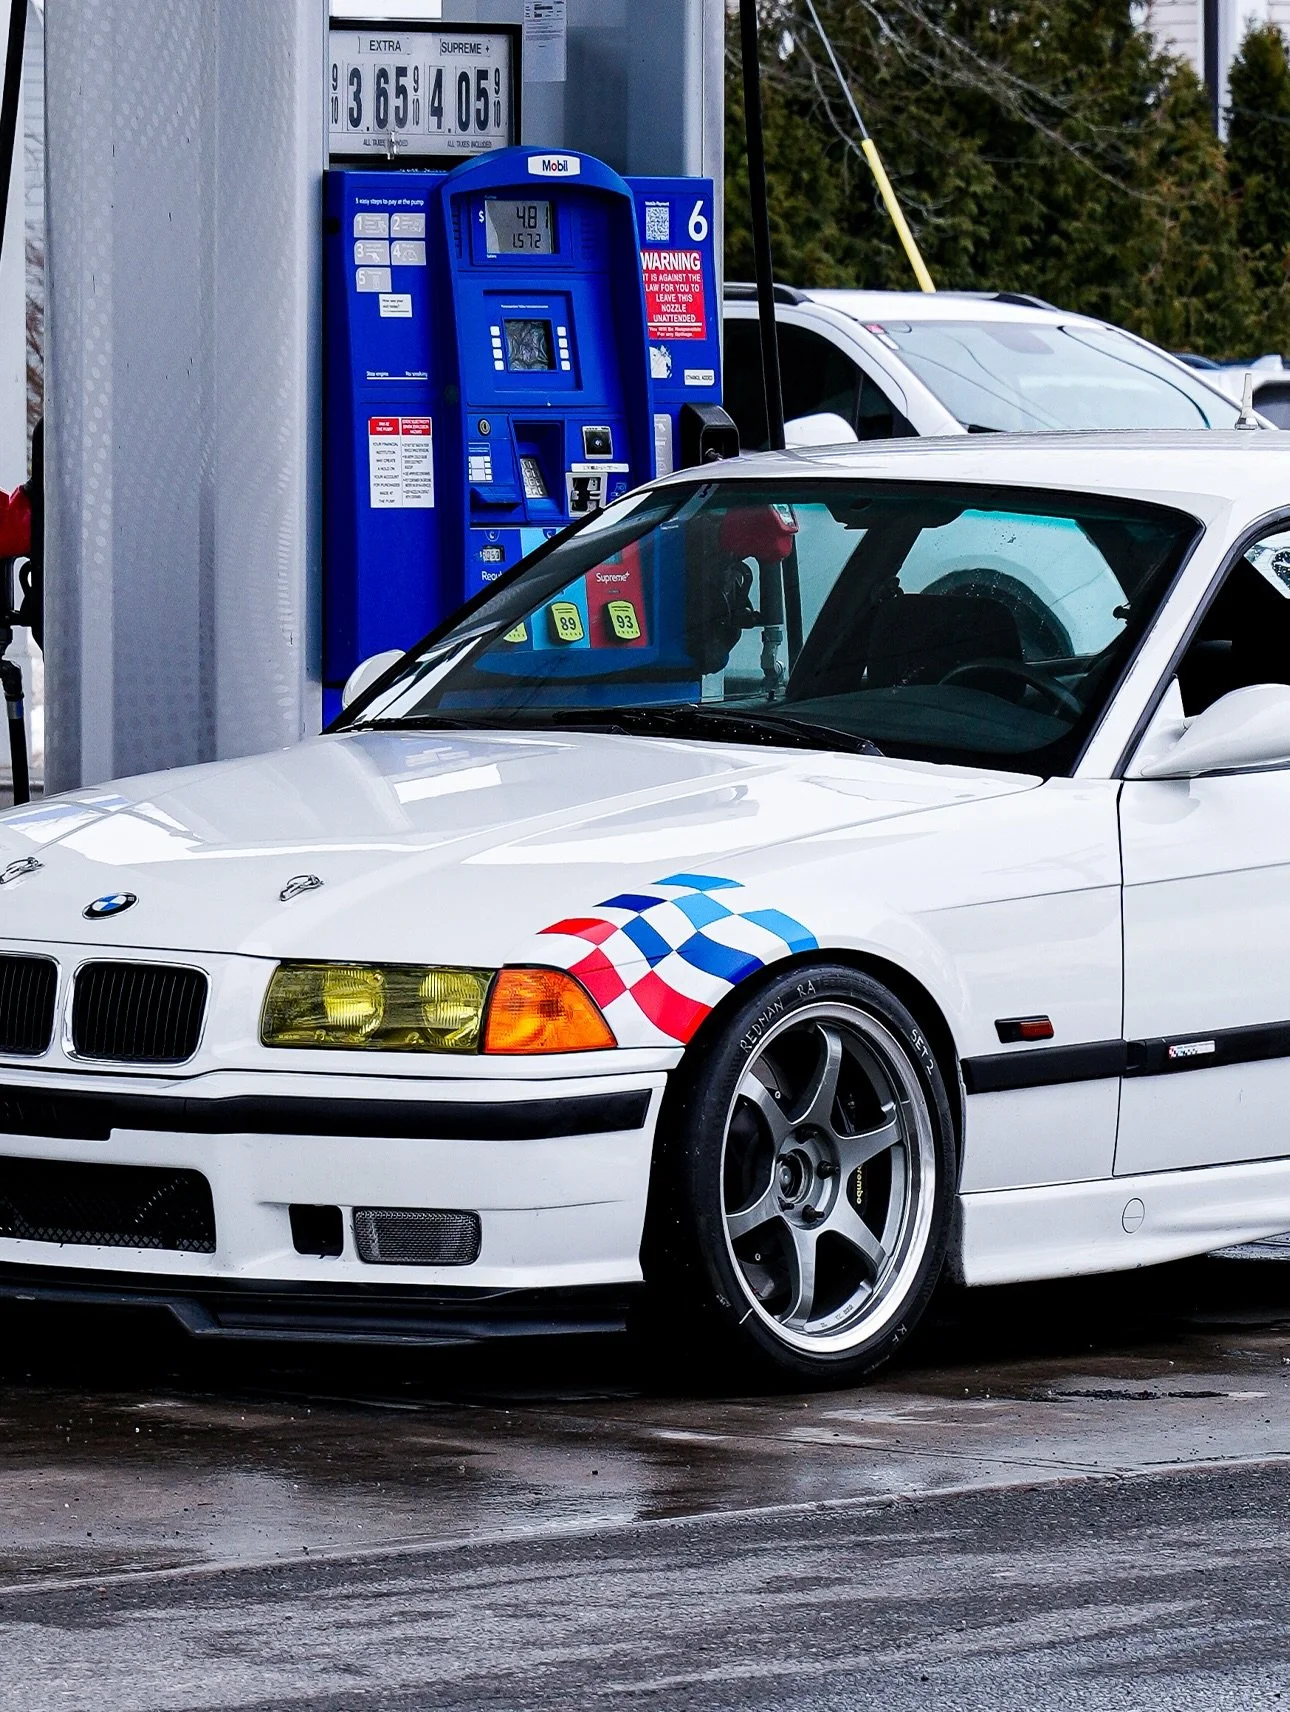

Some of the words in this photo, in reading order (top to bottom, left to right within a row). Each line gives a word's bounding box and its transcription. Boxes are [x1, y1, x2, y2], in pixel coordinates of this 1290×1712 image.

[369, 40, 402, 52] EXTRA
[441, 41, 482, 54] SUPREME
[456, 140, 470, 148] TAXES
[542, 160, 568, 172] Mobil
[357, 216, 362, 230] 1
[393, 216, 400, 230] 2
[478, 210, 485, 223] $
[689, 200, 708, 241] 6
[357, 243, 364, 257] 3
[393, 244, 400, 258] 4
[640, 252, 700, 270] WARNING
[358, 271, 366, 285] 5
[643, 273, 648, 281] IT
[659, 274, 686, 282] AGAINST
[688, 274, 700, 282] THE
[645, 284, 659, 292] LAW
[661, 284, 674, 292] FOR
[675, 284, 689, 292] YOU
[691, 284, 699, 292] TO
[656, 294, 676, 302] LEAVE
[678, 294, 693, 302] THIS
[661, 304, 686, 312] NOZZLE
[653, 314, 696, 322] UNATTENDED
[560, 616, 577, 631] 89
[616, 614, 633, 629] 93
[740, 996, 784, 1054] REDMAN
[797, 980, 816, 997] RA
[911, 1029, 929, 1057] SET
[926, 1059, 934, 1076] 2
